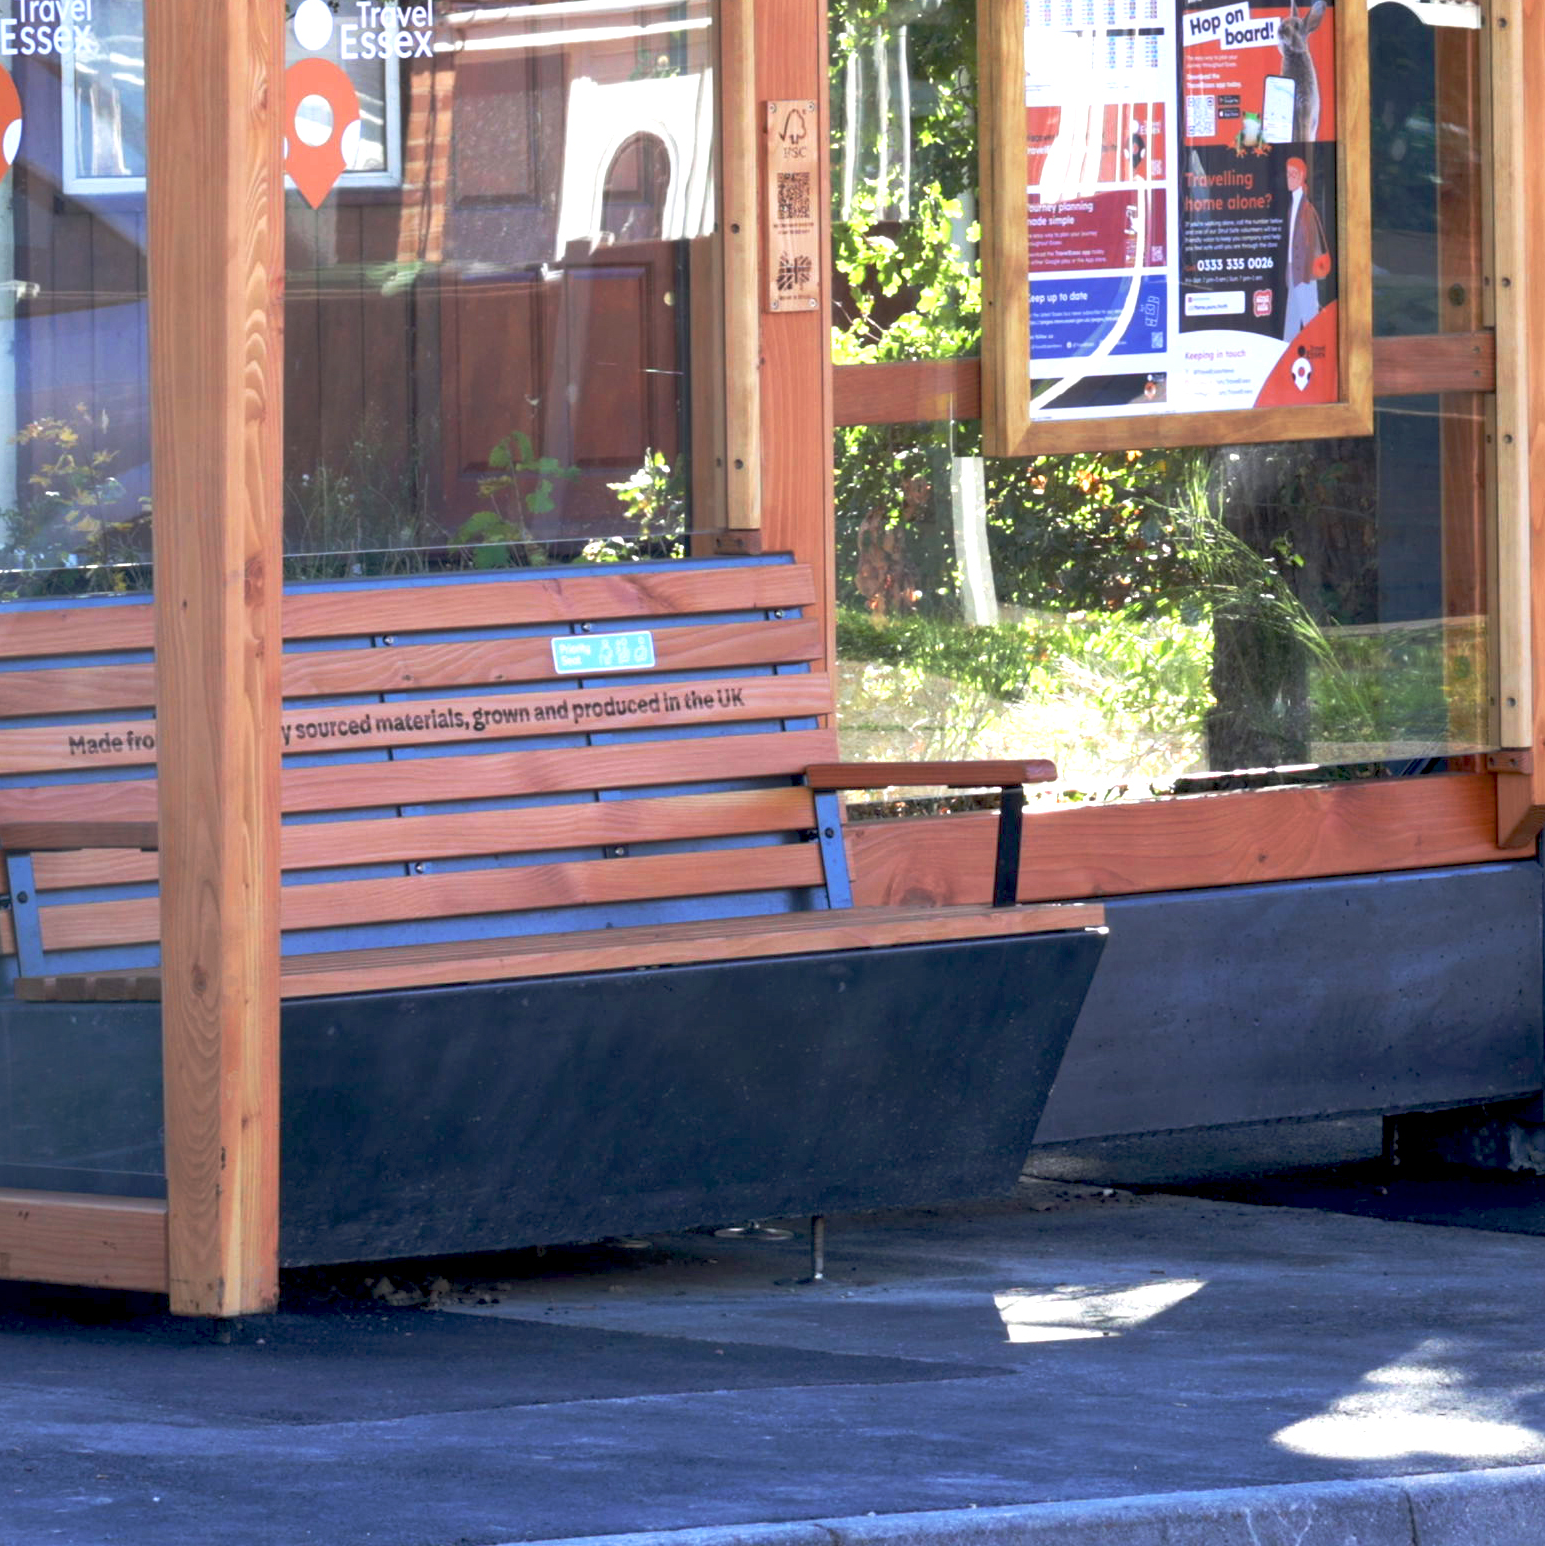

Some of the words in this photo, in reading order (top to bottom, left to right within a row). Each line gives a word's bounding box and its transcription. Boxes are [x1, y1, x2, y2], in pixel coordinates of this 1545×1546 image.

[1190, 16, 1221, 36] Hop
[1225, 8, 1244, 25] on
[0, 18, 92, 56] Essex
[341, 24, 433, 60] Essex
[1225, 21, 1274, 45] board!
[1184, 170, 1253, 190] Travelling
[1058, 200, 1094, 213] planning
[1185, 195, 1223, 211] home
[1228, 193, 1273, 210] alone?
[1048, 215, 1075, 226] simple
[1197, 258, 1223, 271] 0333
[1226, 257, 1245, 270] 335
[1247, 256, 1274, 269] 0026
[1046, 294, 1058, 304] up
[1059, 292, 1068, 301] to
[1069, 291, 1088, 301] date
[1185, 350, 1214, 361] Keeping
[1216, 349, 1223, 358] in
[1225, 348, 1246, 357] touch
[559, 643, 591, 655] Priority
[68, 732, 123, 755] Made
[127, 730, 154, 751] fro
[295, 714, 371, 739] sourced
[375, 708, 470, 733] materials,
[472, 706, 530, 732] grown
[534, 699, 569, 722] and
[573, 696, 660, 724] produced
[664, 691, 681, 712] in
[684, 690, 715, 710] the
[717, 688, 746, 708] UK
